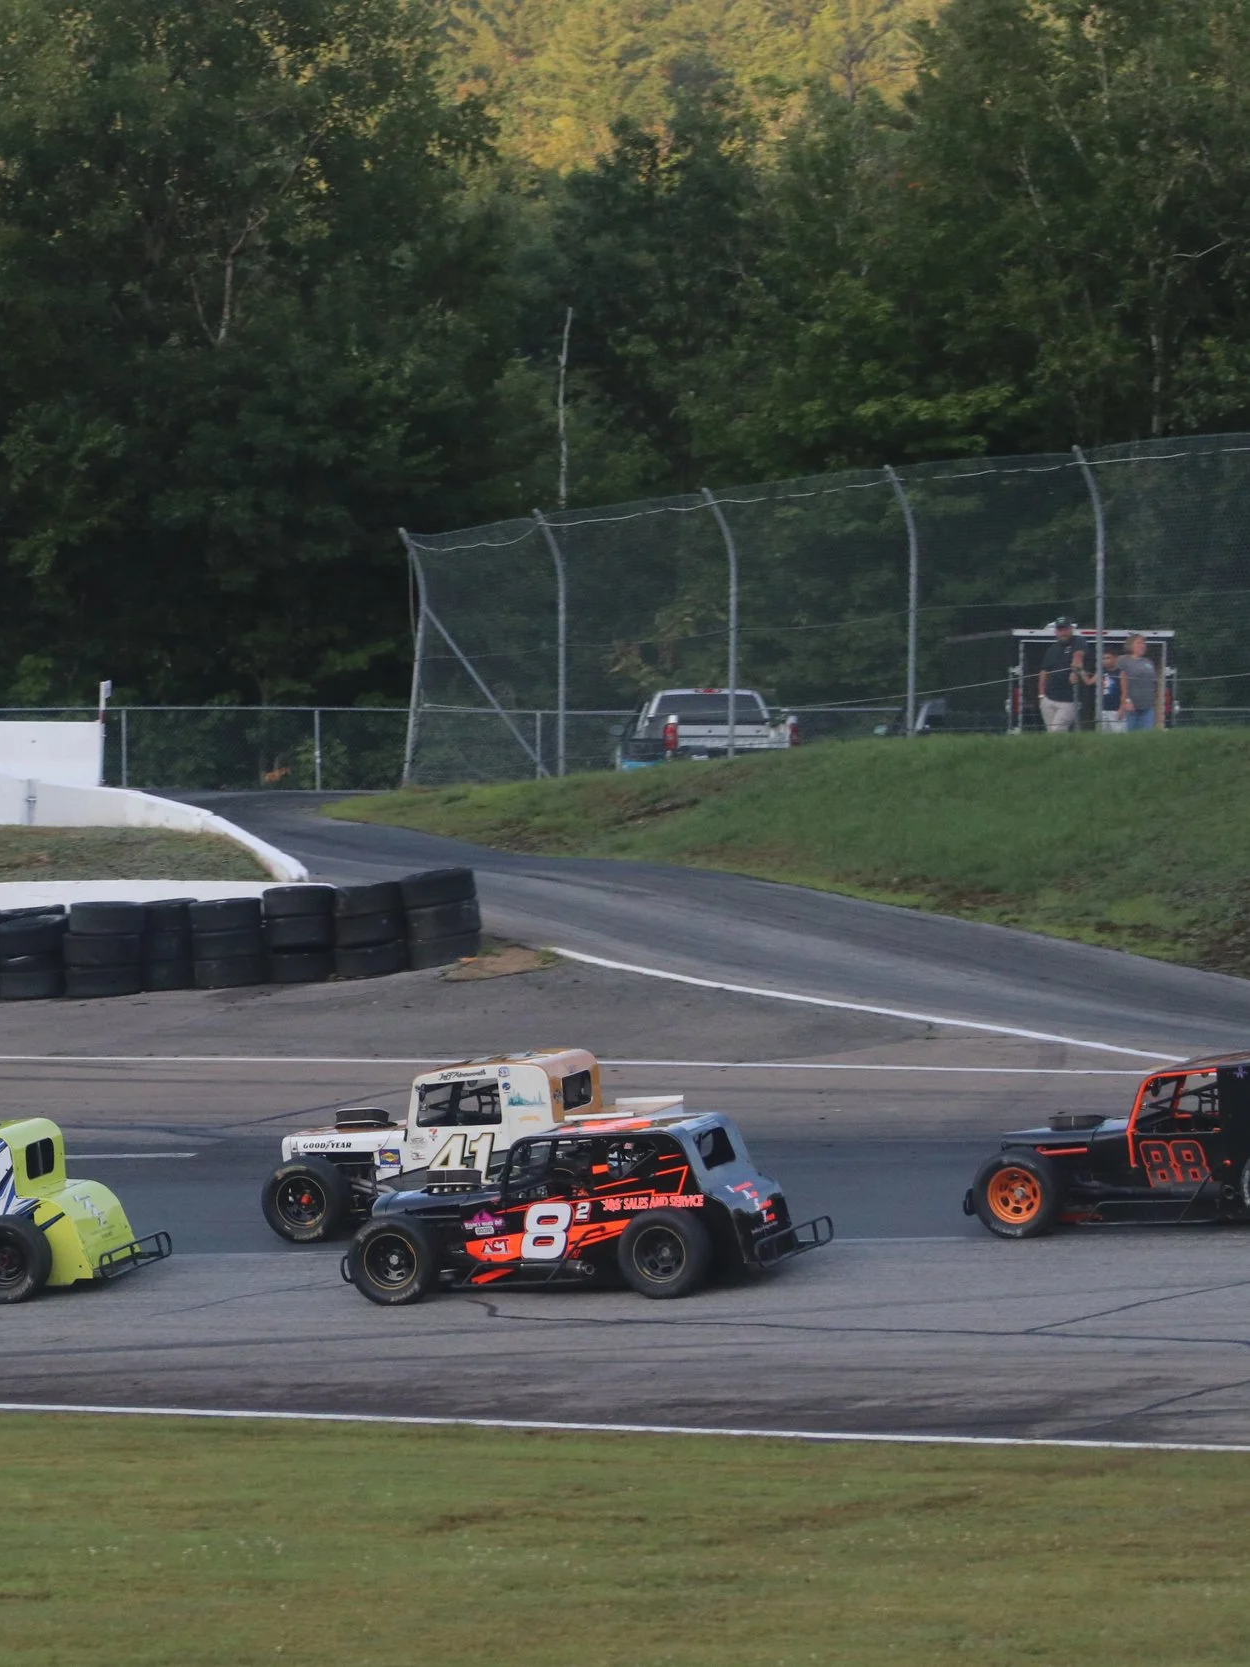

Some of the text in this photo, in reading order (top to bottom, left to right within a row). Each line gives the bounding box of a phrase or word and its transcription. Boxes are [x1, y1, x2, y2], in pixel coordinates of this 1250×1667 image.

[429, 1132, 495, 1183] 41
[1139, 1140, 1213, 1188] 88
[623, 1197, 649, 1210] SALES
[649, 1196, 669, 1208] AND
[669, 1194, 704, 1208] SERVICE
[521, 1201, 573, 1260] 8
